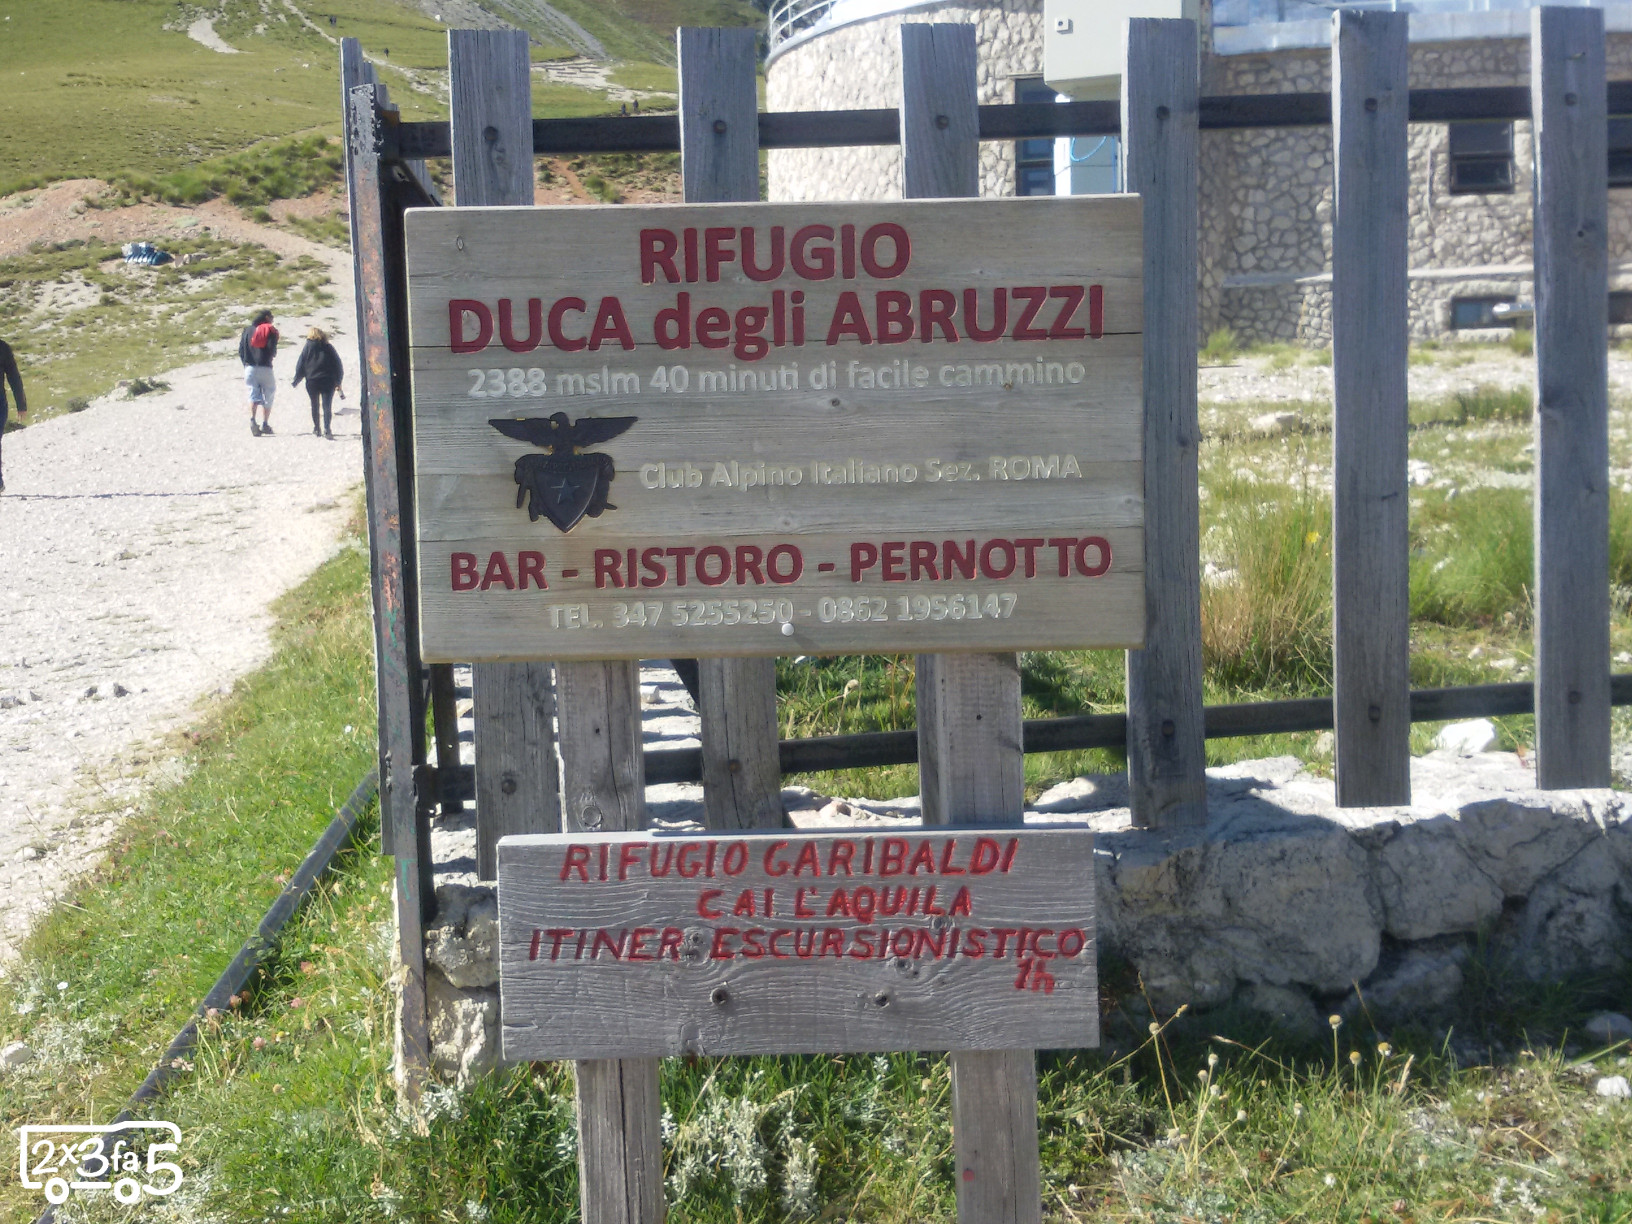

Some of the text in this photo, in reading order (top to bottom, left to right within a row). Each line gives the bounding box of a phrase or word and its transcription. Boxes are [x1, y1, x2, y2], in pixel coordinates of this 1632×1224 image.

[640, 222, 911, 284] RIFUGIO
[449, 285, 1104, 361] DUCA degli ABRUZZI
[467, 356, 1086, 397] 2388 mslm 40 minuti di facile cammino
[639, 454, 1083, 491] Club Alpino Italiano Sez. ROMA
[450, 536, 1113, 591] BAR - RISTORO - PERNOTTO
[549, 602, 604, 630] TEL.
[613, 602, 665, 627] 347
[671, 599, 794, 626] 5255250
[817, 596, 889, 622] 0862
[896, 592, 1018, 621] 1956147
[559, 836, 1019, 883] RIFUGIO GARIBALDI
[697, 884, 972, 924] CAI L'AQUILA
[709, 926, 1086, 961] ESCURSIONISTICO
[1014, 957, 1055, 995] 1h
